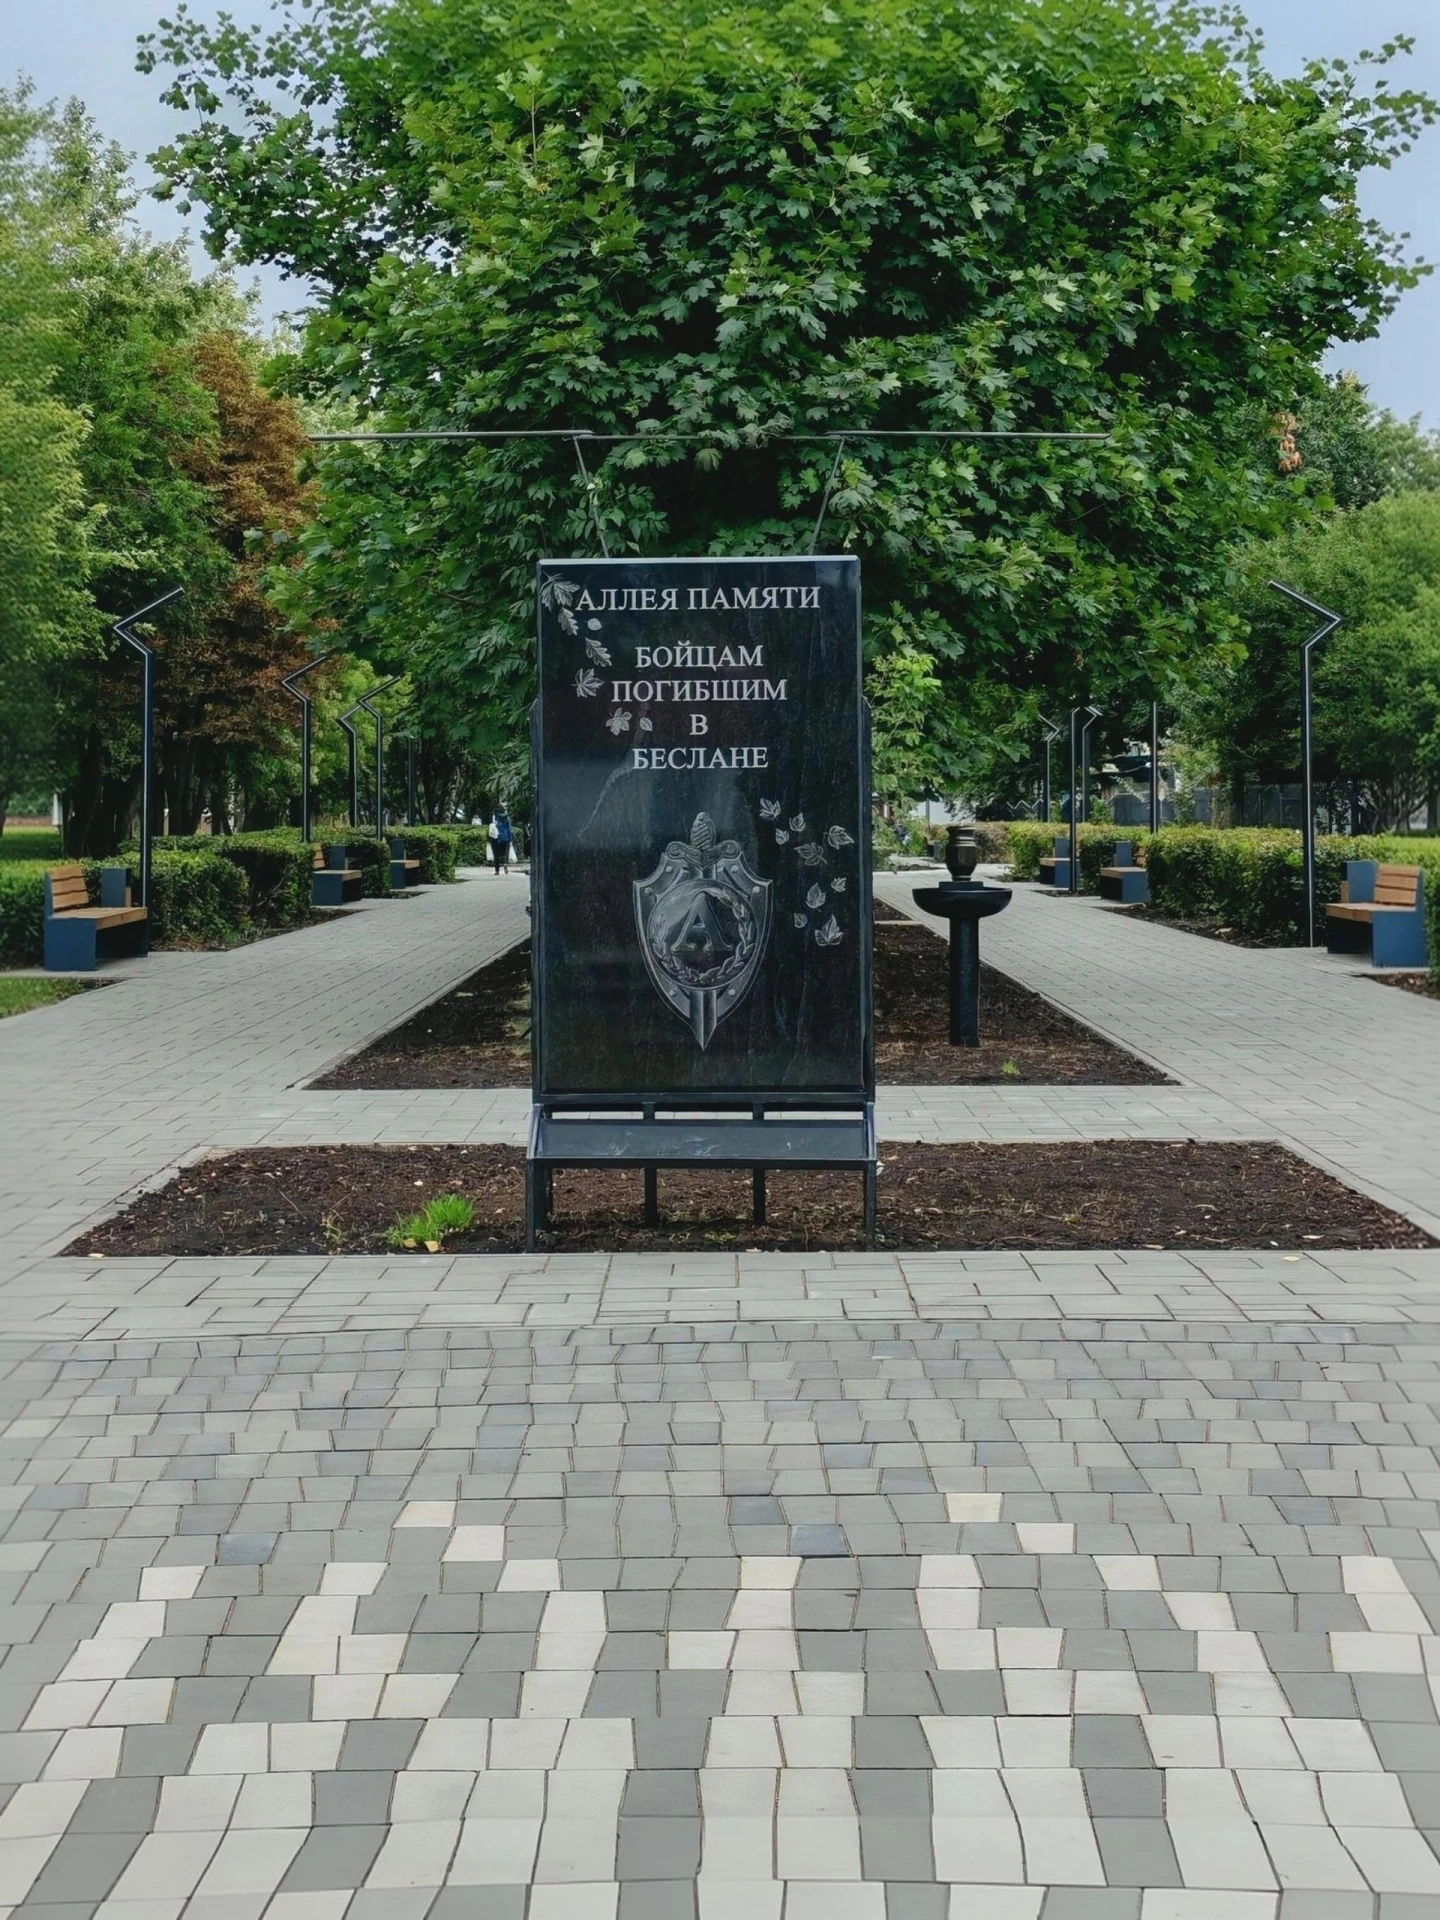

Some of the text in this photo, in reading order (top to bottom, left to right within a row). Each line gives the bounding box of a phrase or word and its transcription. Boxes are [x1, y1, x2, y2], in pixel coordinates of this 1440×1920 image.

[575, 586, 821, 611] АЛЛЕЯ ПАМЯТИ
[635, 640, 764, 671] БОЙЦАМ
[611, 679, 788, 702] ПОГИБШИМ
[689, 714, 709, 735] В
[632, 747, 769, 770] БЕСЛАНЕ
